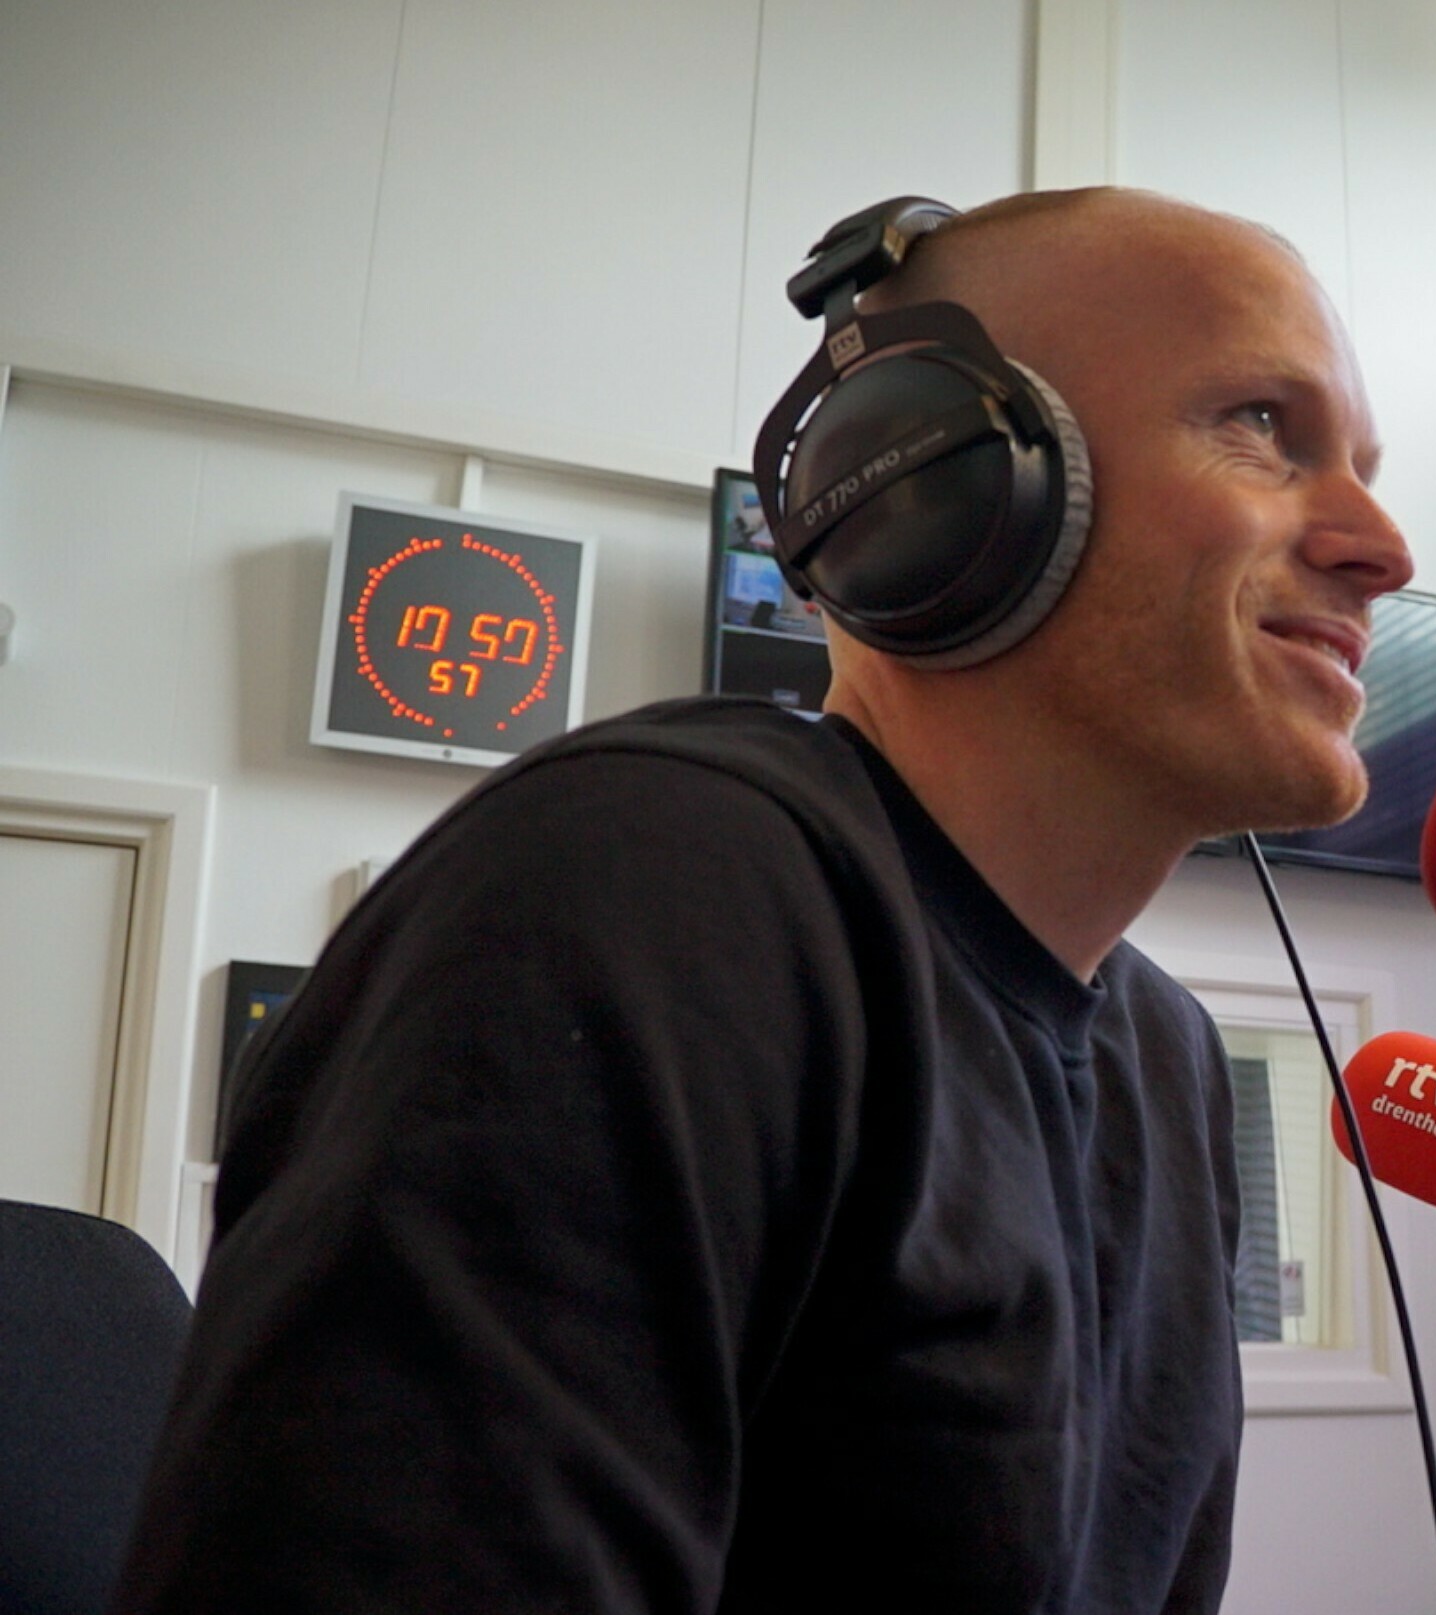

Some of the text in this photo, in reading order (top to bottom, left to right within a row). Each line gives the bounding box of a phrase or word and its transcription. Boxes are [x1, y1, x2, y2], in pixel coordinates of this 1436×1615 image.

[803, 448, 901, 527] DT 770 PRO
[428, 659, 482, 698] 57
